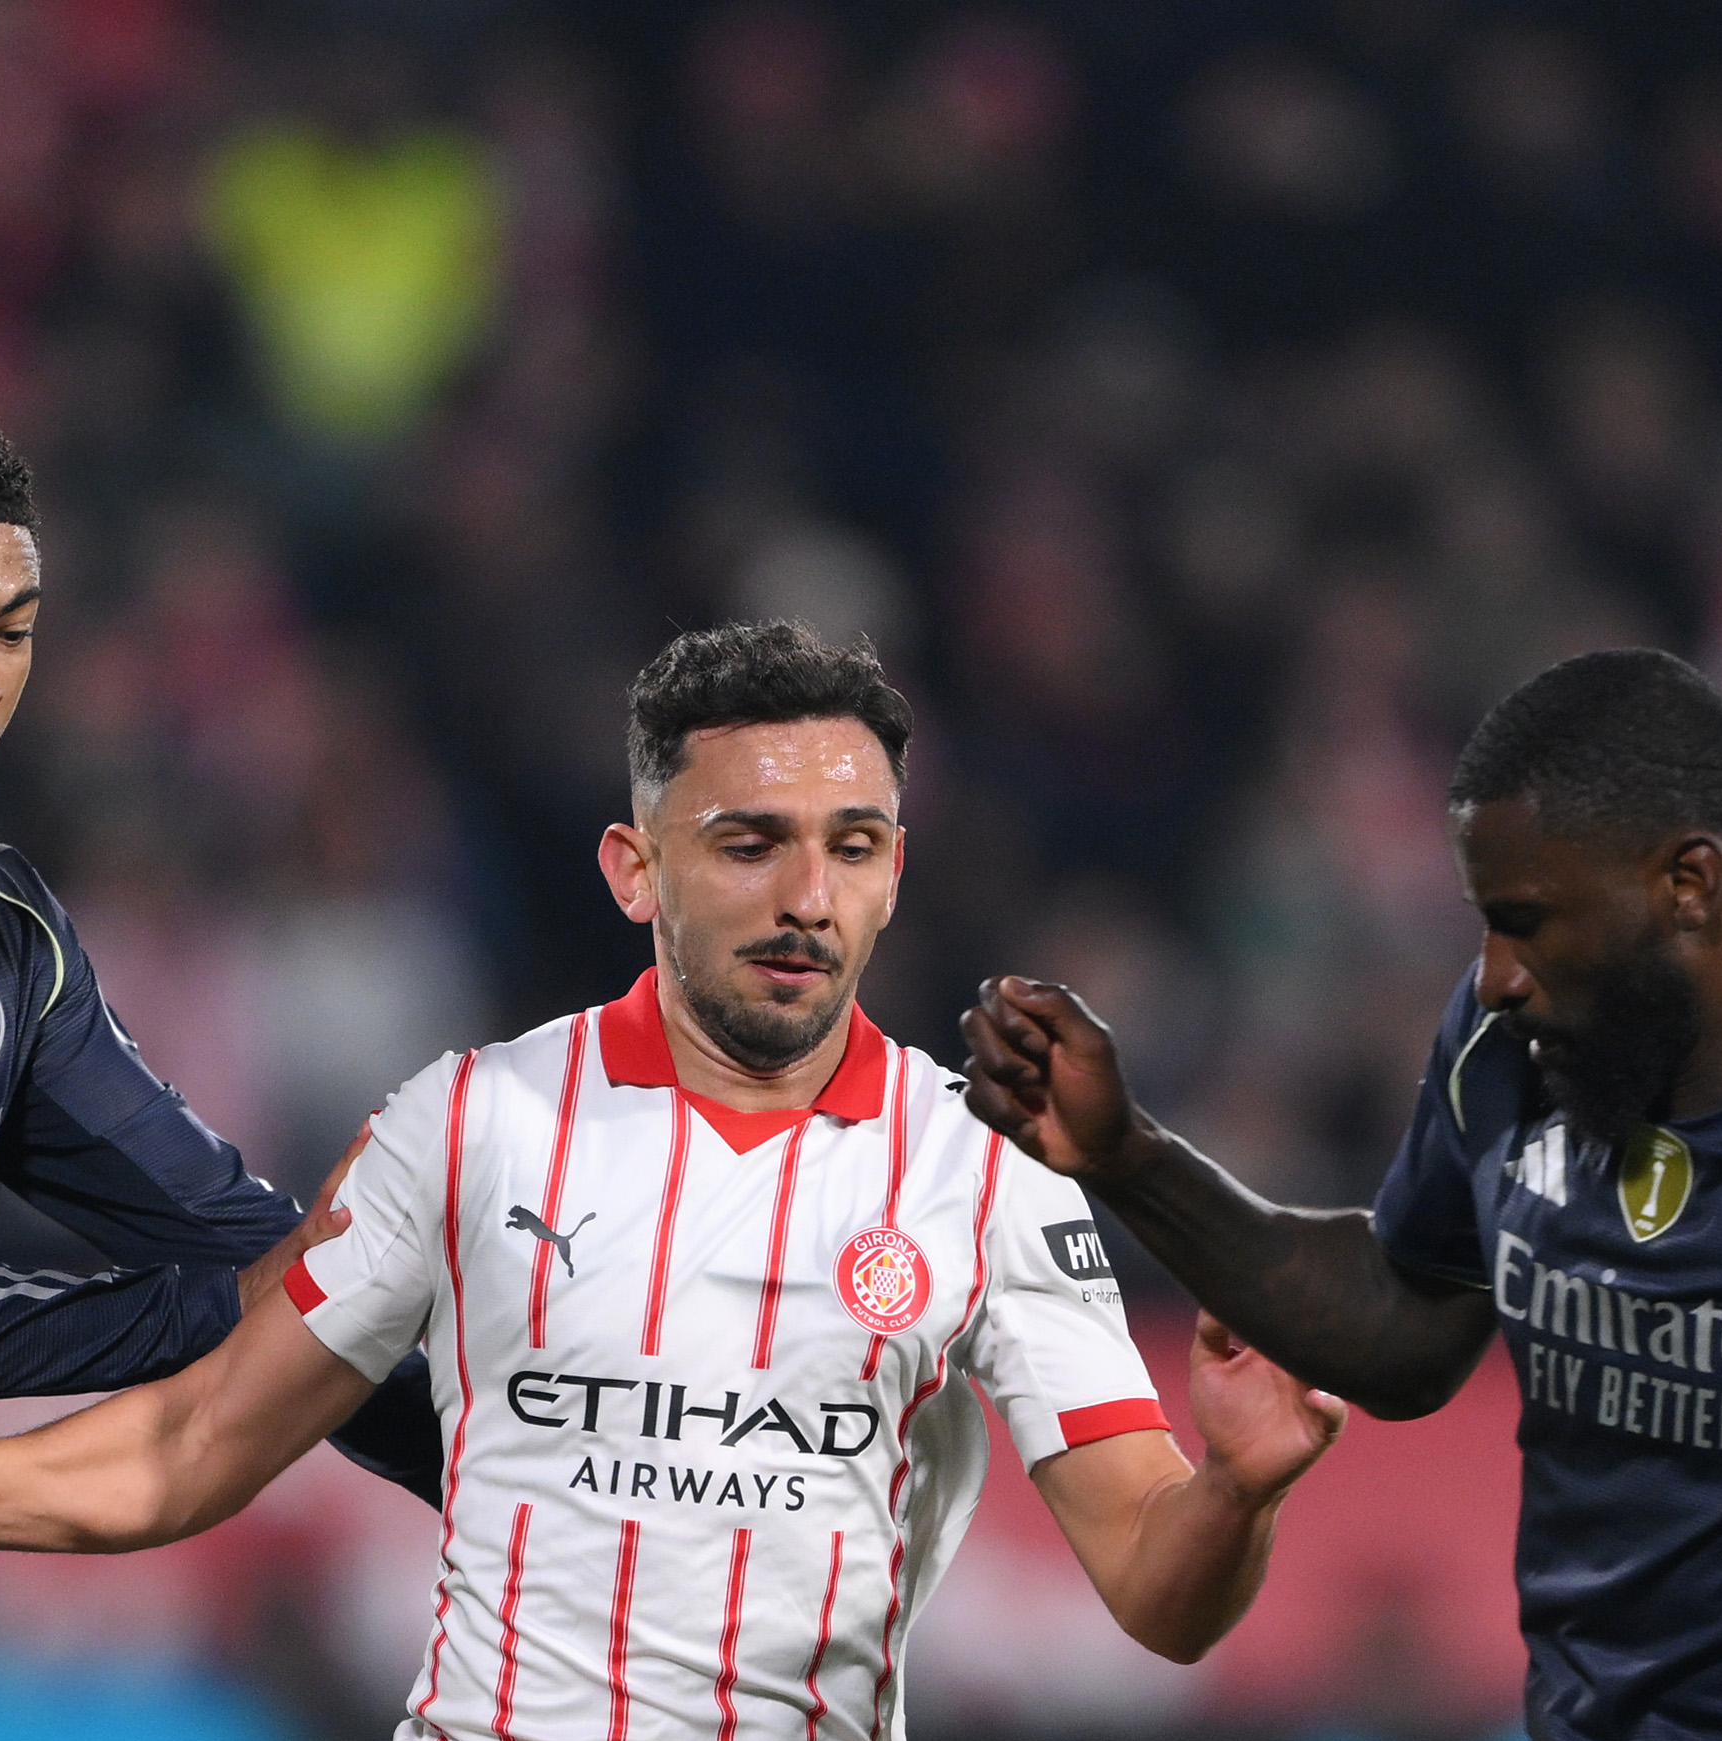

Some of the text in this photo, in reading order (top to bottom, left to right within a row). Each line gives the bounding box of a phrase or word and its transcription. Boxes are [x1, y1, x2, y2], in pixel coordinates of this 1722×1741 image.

[854, 1232, 918, 1263] GIRONA
[852, 1303, 912, 1328] FUTBOL CLUB
[1529, 1342, 1584, 1414] FLY
[507, 1370, 880, 1457] ETIHAD
[569, 1456, 805, 1511] AIRWAYS
